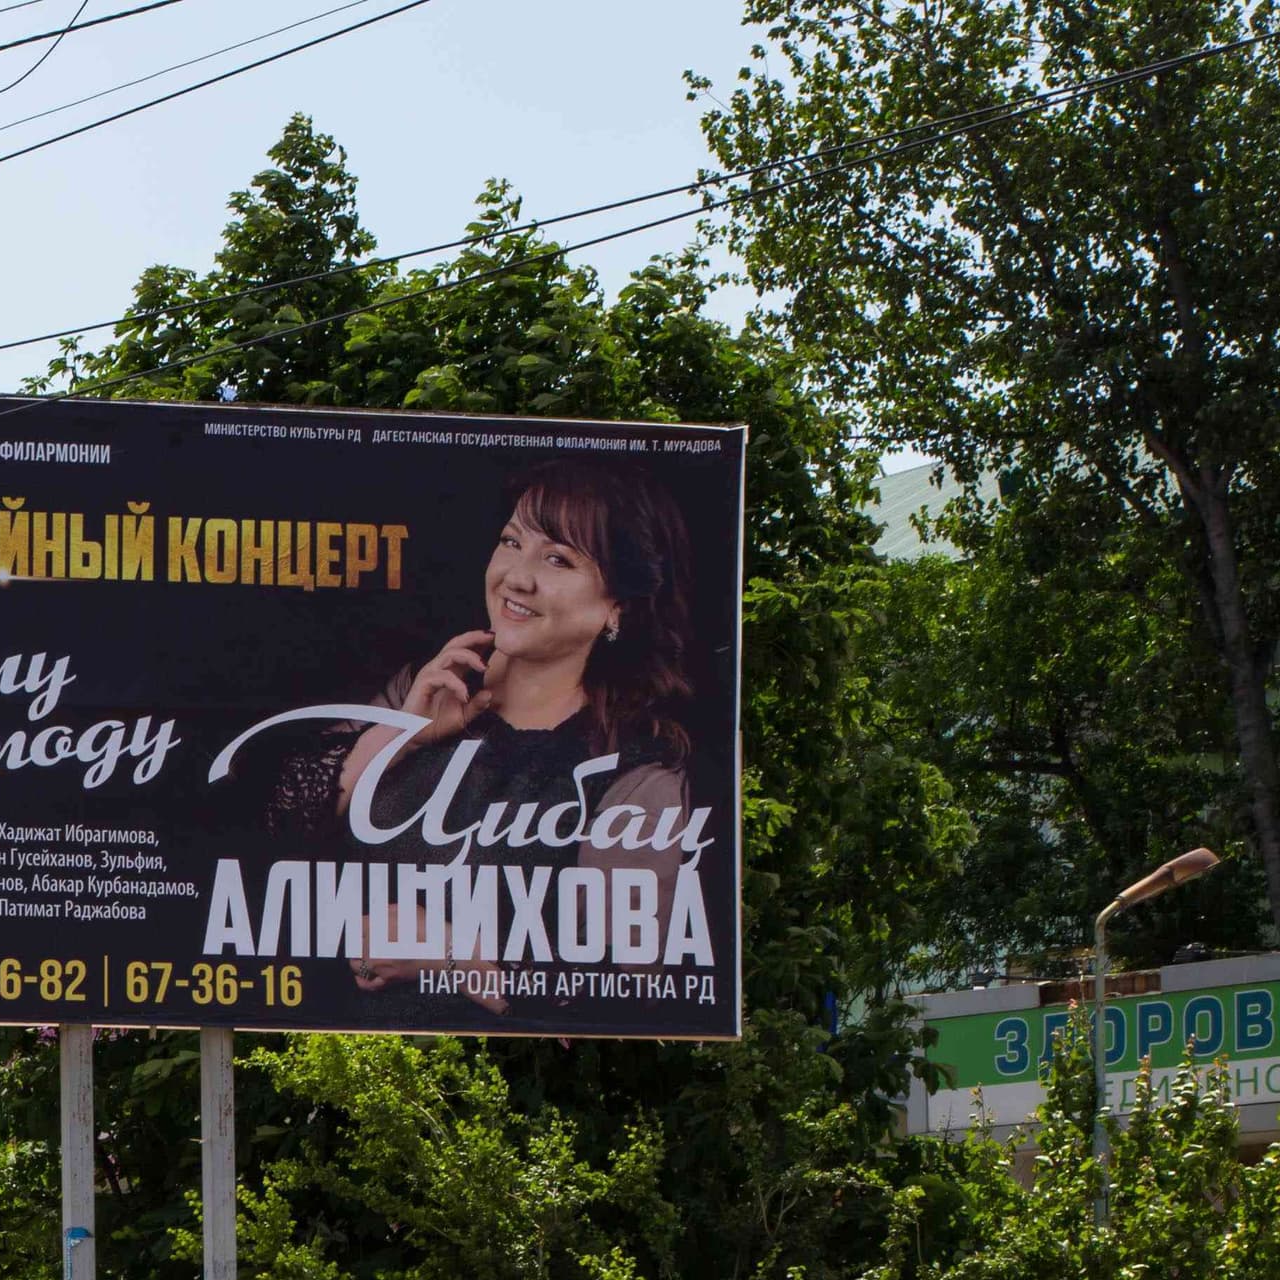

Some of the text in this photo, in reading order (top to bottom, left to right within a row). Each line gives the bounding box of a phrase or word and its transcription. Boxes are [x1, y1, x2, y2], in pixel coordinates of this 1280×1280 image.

[204, 422, 362, 443] МИНИСТЕРСТВО КУЛЬТУРЫ РД
[372, 429, 722, 454] ДАГЕСТАНСКАЯ ГОСУДАРСТВЕННАЯ ФИЛАРМОНИЯ ИМ. Т. МУРАДОВА
[167, 515, 409, 592] КОНЦЕРТ
[207, 703, 716, 873] Цибац
[65, 823, 160, 848] Ибрагимова,
[10, 848, 97, 870] Гусейханов,
[100, 850, 168, 873] Зульфия,
[31, 873, 84, 897] Абакар
[87, 875, 200, 899] Курбанадамов,
[64, 900, 147, 921] Раджабова
[202, 857, 716, 967] АЛИШИХОВА
[125, 961, 303, 1007] 67-36-16
[419, 969, 716, 1005] НАРОДНАЯ АРТИСТКА РД
